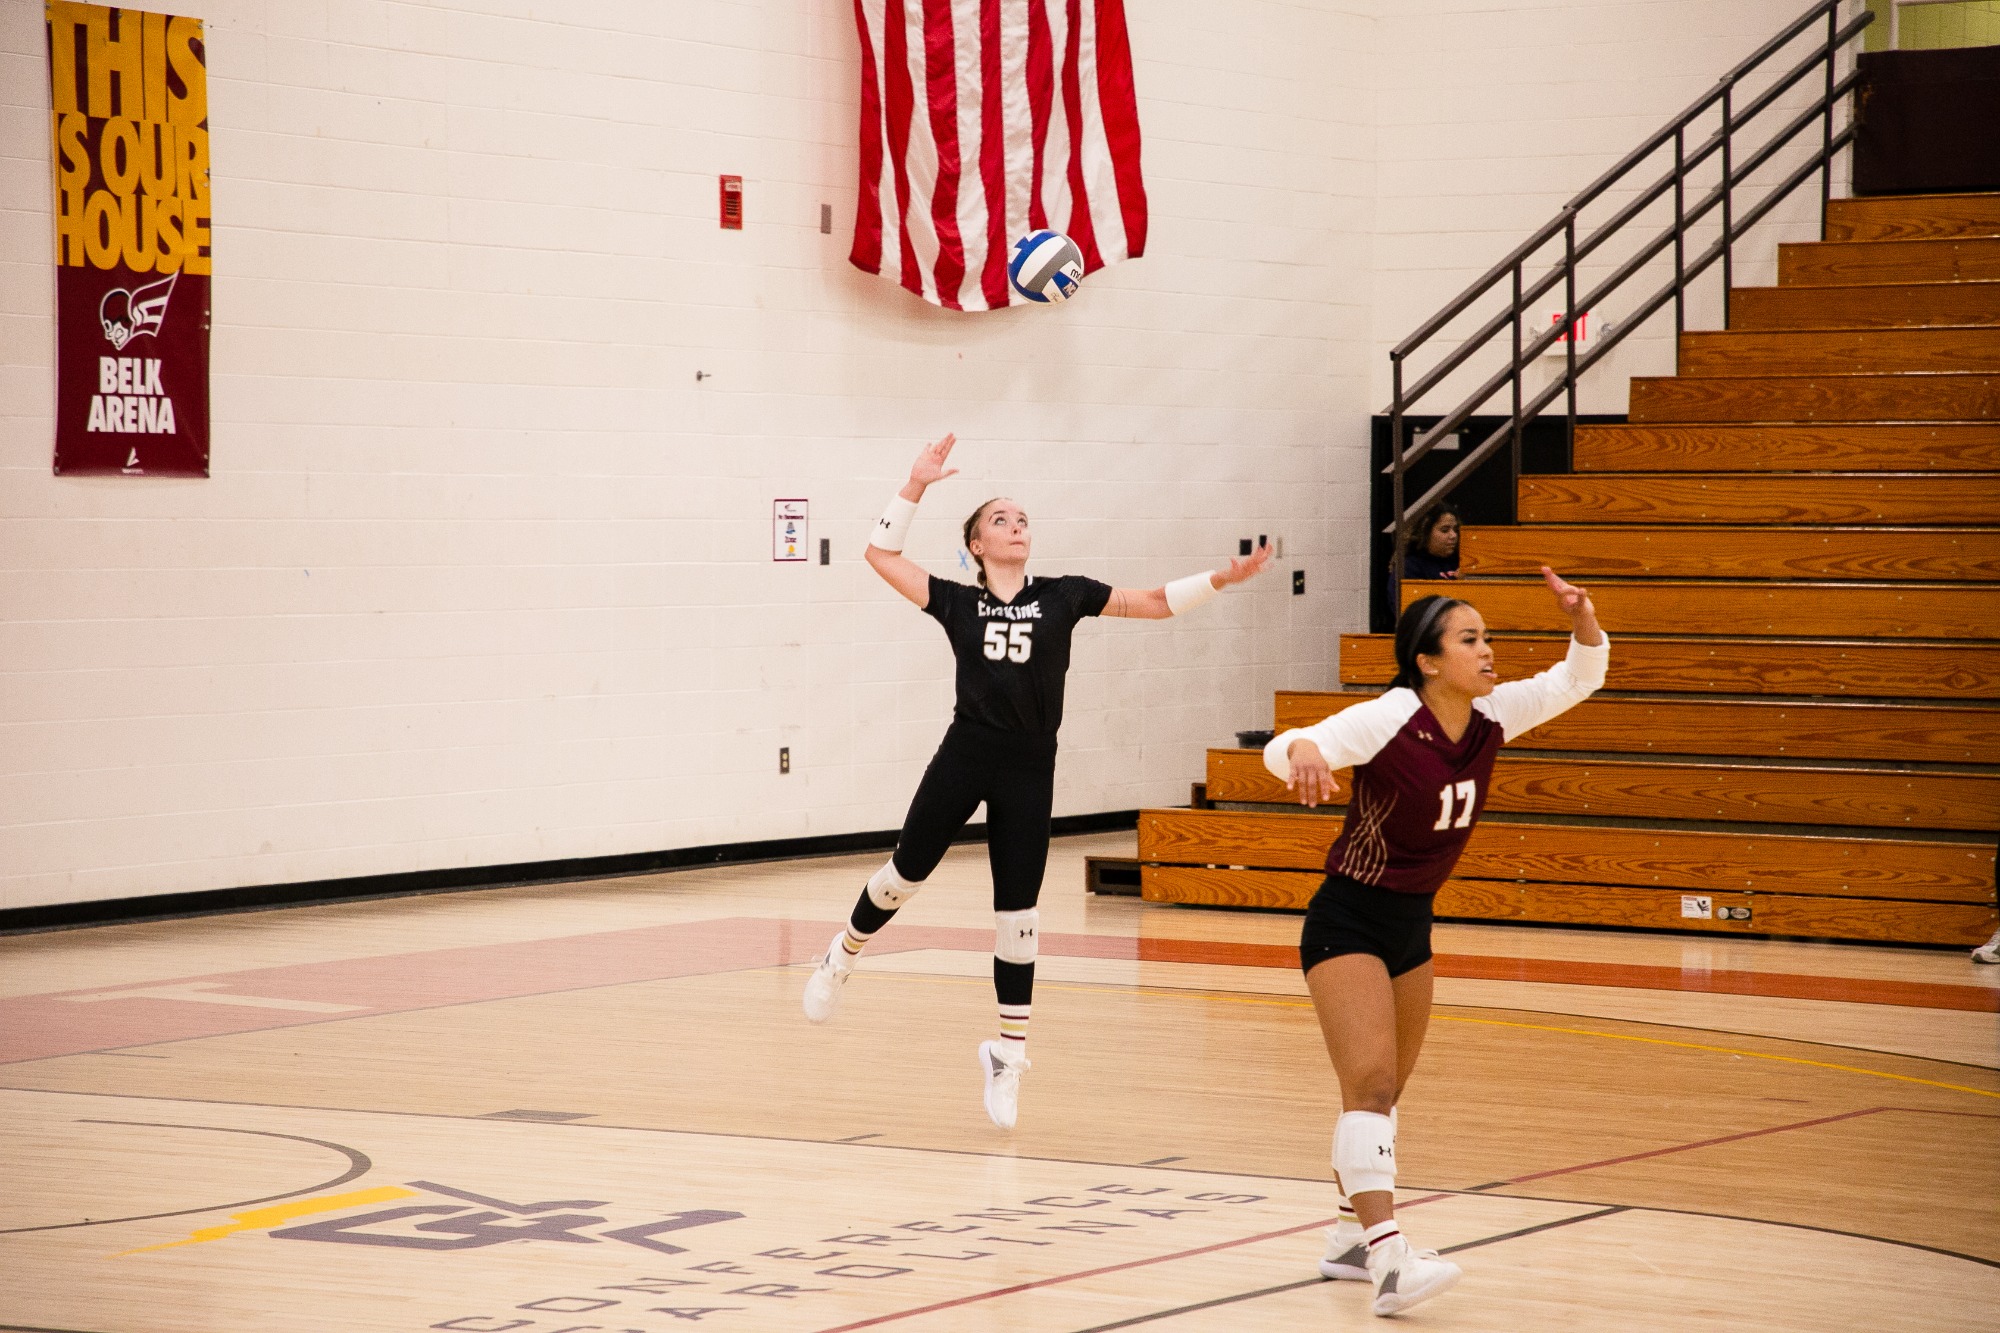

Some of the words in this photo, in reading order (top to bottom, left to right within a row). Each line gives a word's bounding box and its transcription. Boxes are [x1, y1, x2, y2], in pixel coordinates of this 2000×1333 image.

[45, 0, 207, 126] THIS
[101, 115, 211, 199] OUR
[54, 189, 212, 275] HOUSE
[1552, 312, 1588, 341] EIT
[99, 356, 164, 395] BELK
[87, 395, 176, 434] ARENA
[983, 622, 1033, 663] 55
[1433, 779, 1476, 831] 17
[429, 1184, 1174, 1332] CONFERENCE
